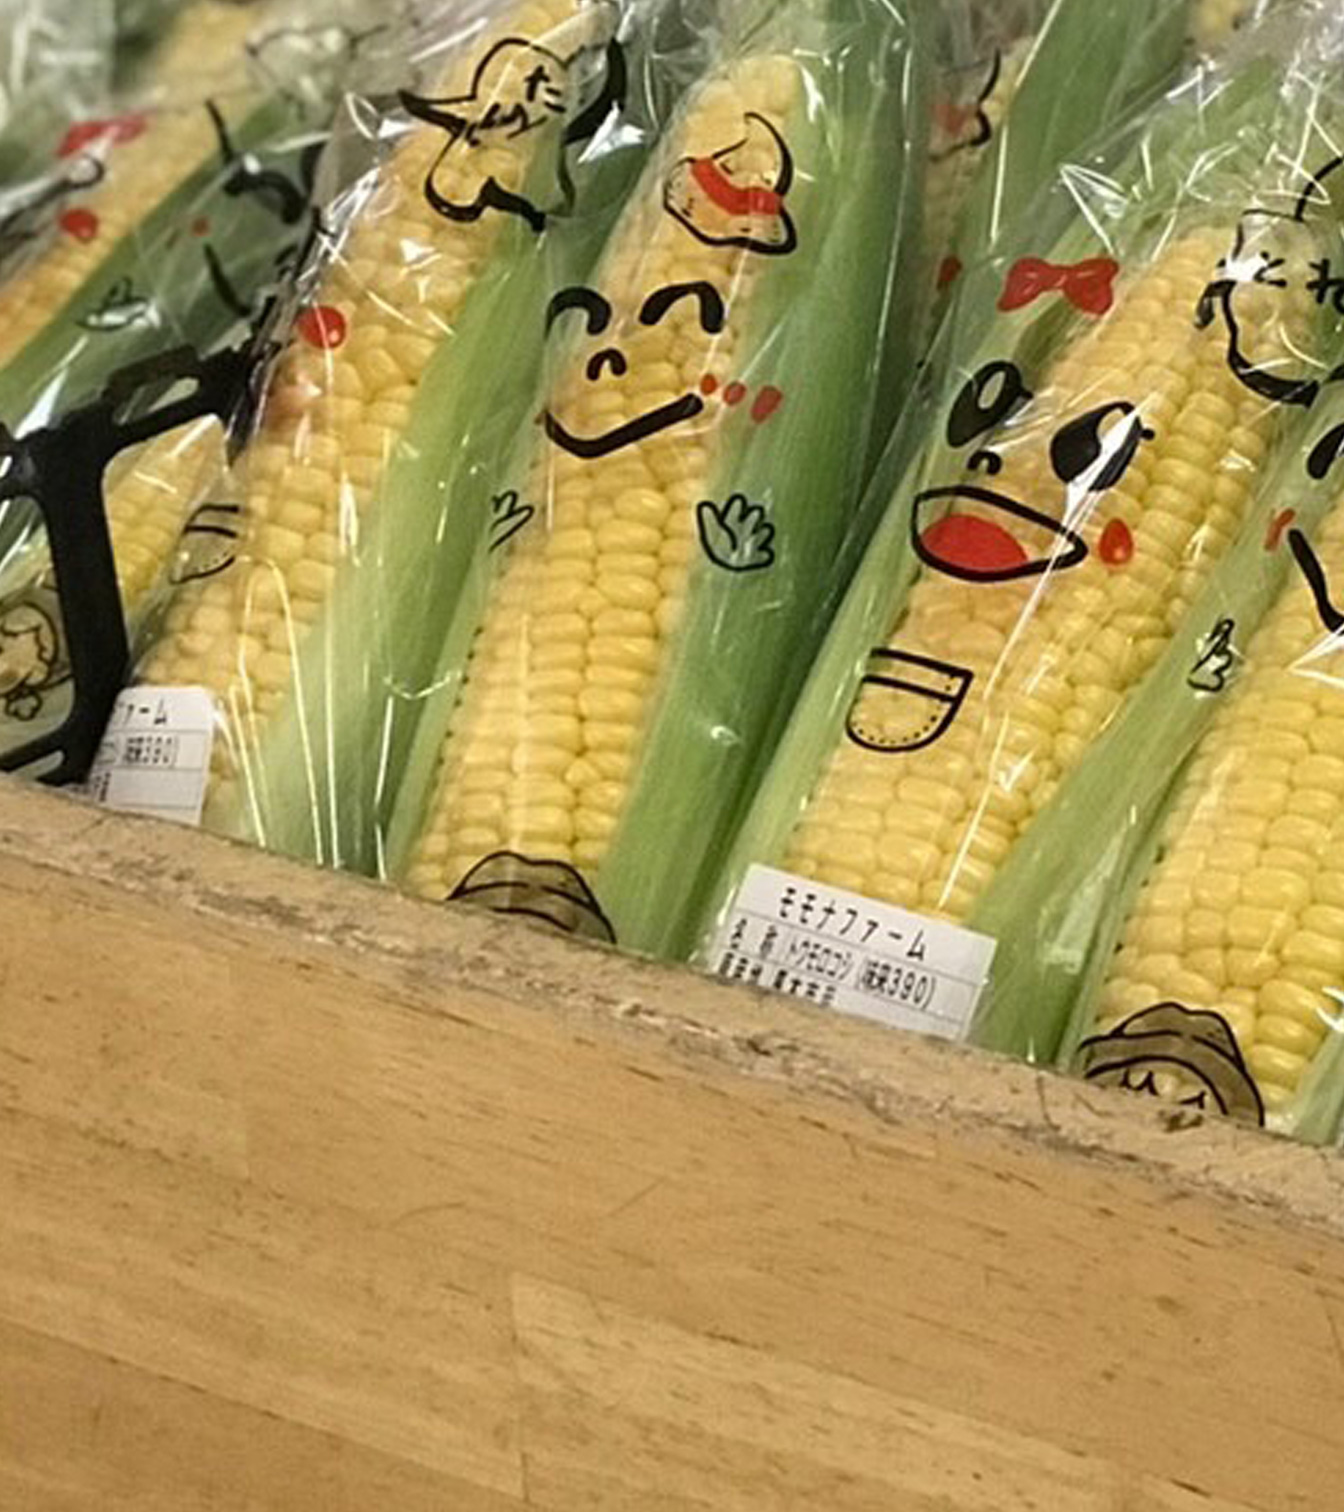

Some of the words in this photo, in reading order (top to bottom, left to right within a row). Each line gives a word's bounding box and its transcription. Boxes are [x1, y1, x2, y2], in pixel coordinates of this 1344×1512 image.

[779, 886, 926, 963] モモナファーム
